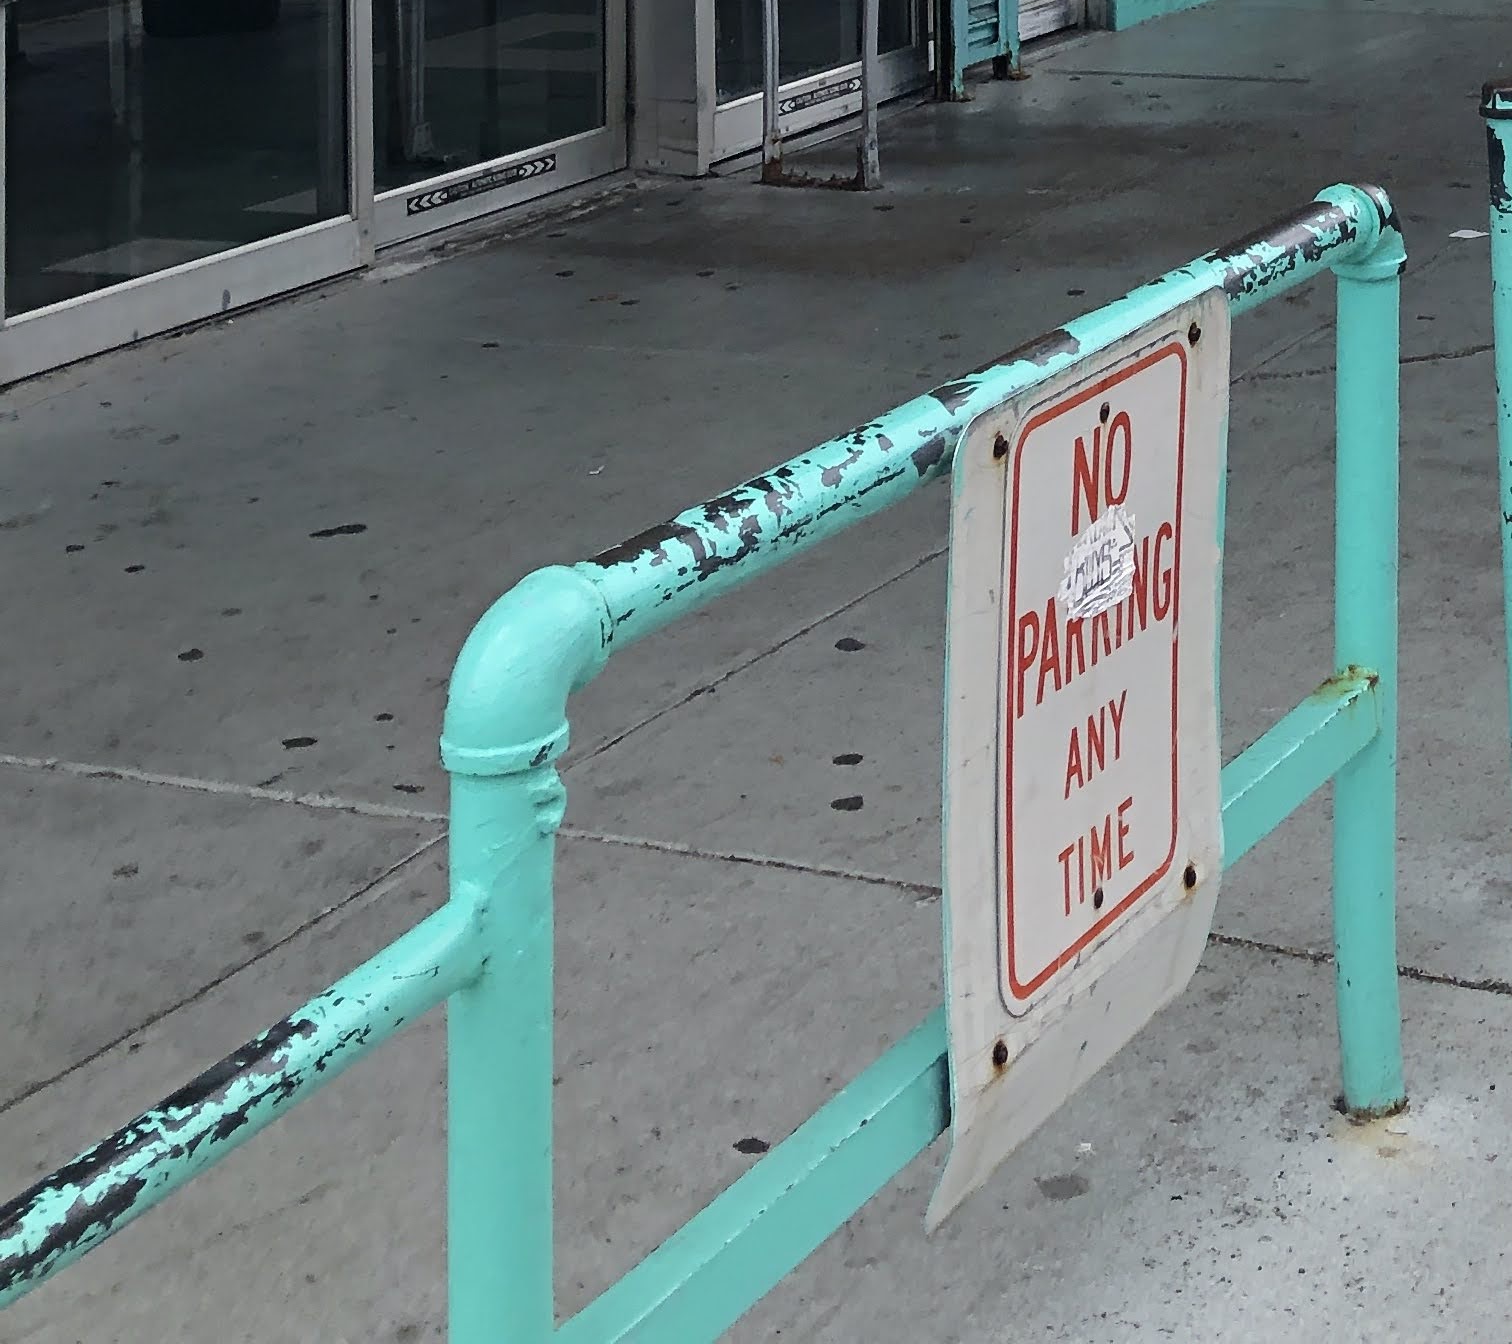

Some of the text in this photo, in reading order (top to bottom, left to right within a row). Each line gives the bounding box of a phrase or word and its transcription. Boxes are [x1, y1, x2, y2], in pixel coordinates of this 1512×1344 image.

[1071, 410, 1133, 536] NO
[1064, 690, 1126, 800] ANY
[1058, 797, 1135, 916] TIME
